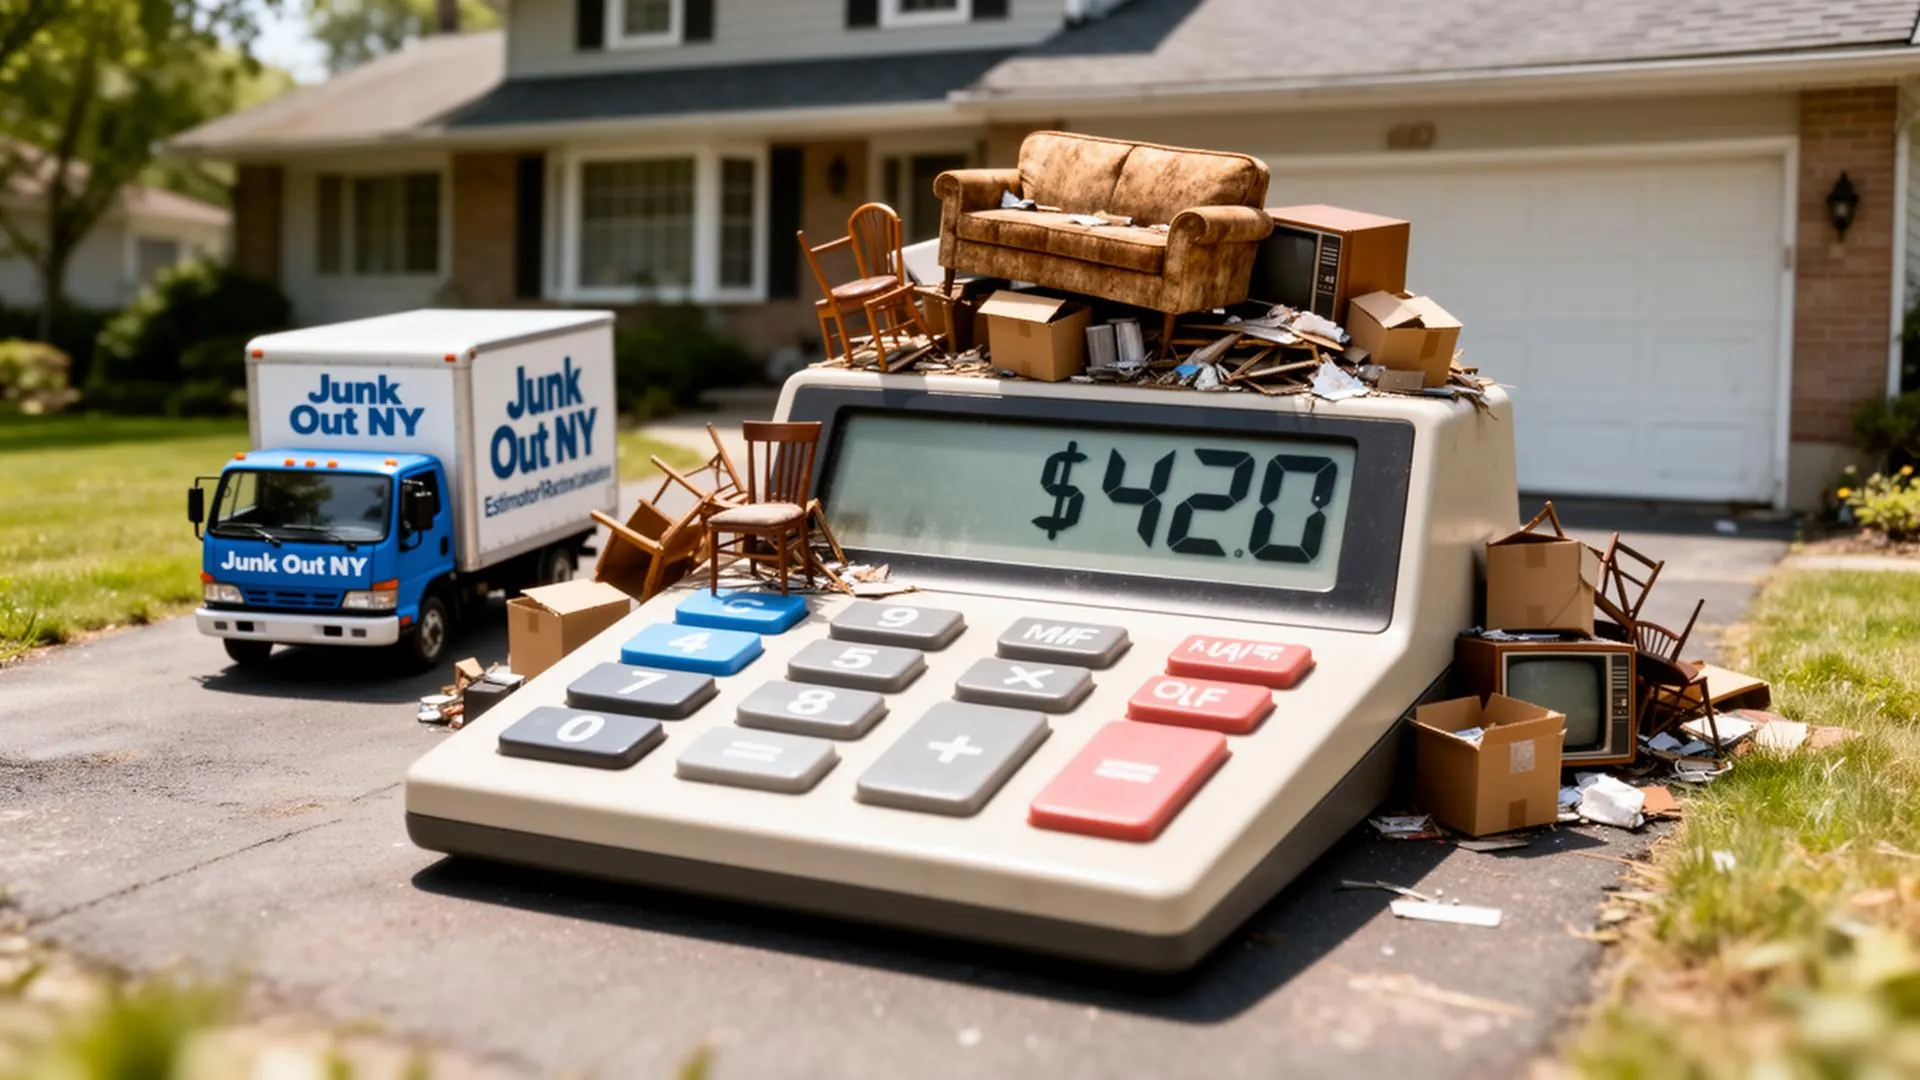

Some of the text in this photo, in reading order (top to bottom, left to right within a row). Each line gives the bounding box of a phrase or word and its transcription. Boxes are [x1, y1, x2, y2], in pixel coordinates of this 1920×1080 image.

[308, 373, 402, 405] Junk
[506, 355, 583, 420] Junk
[289, 404, 426, 437] Out NY
[490, 406, 598, 480] Out NY
[220, 550, 368, 577] Junk Out NY
[877, 607, 920, 628] 9
[667, 632, 712, 654] 4
[831, 647, 878, 670] 5
[615, 671, 668, 694] 7
[786, 688, 837, 715] 8
[556, 714, 606, 743] 0
